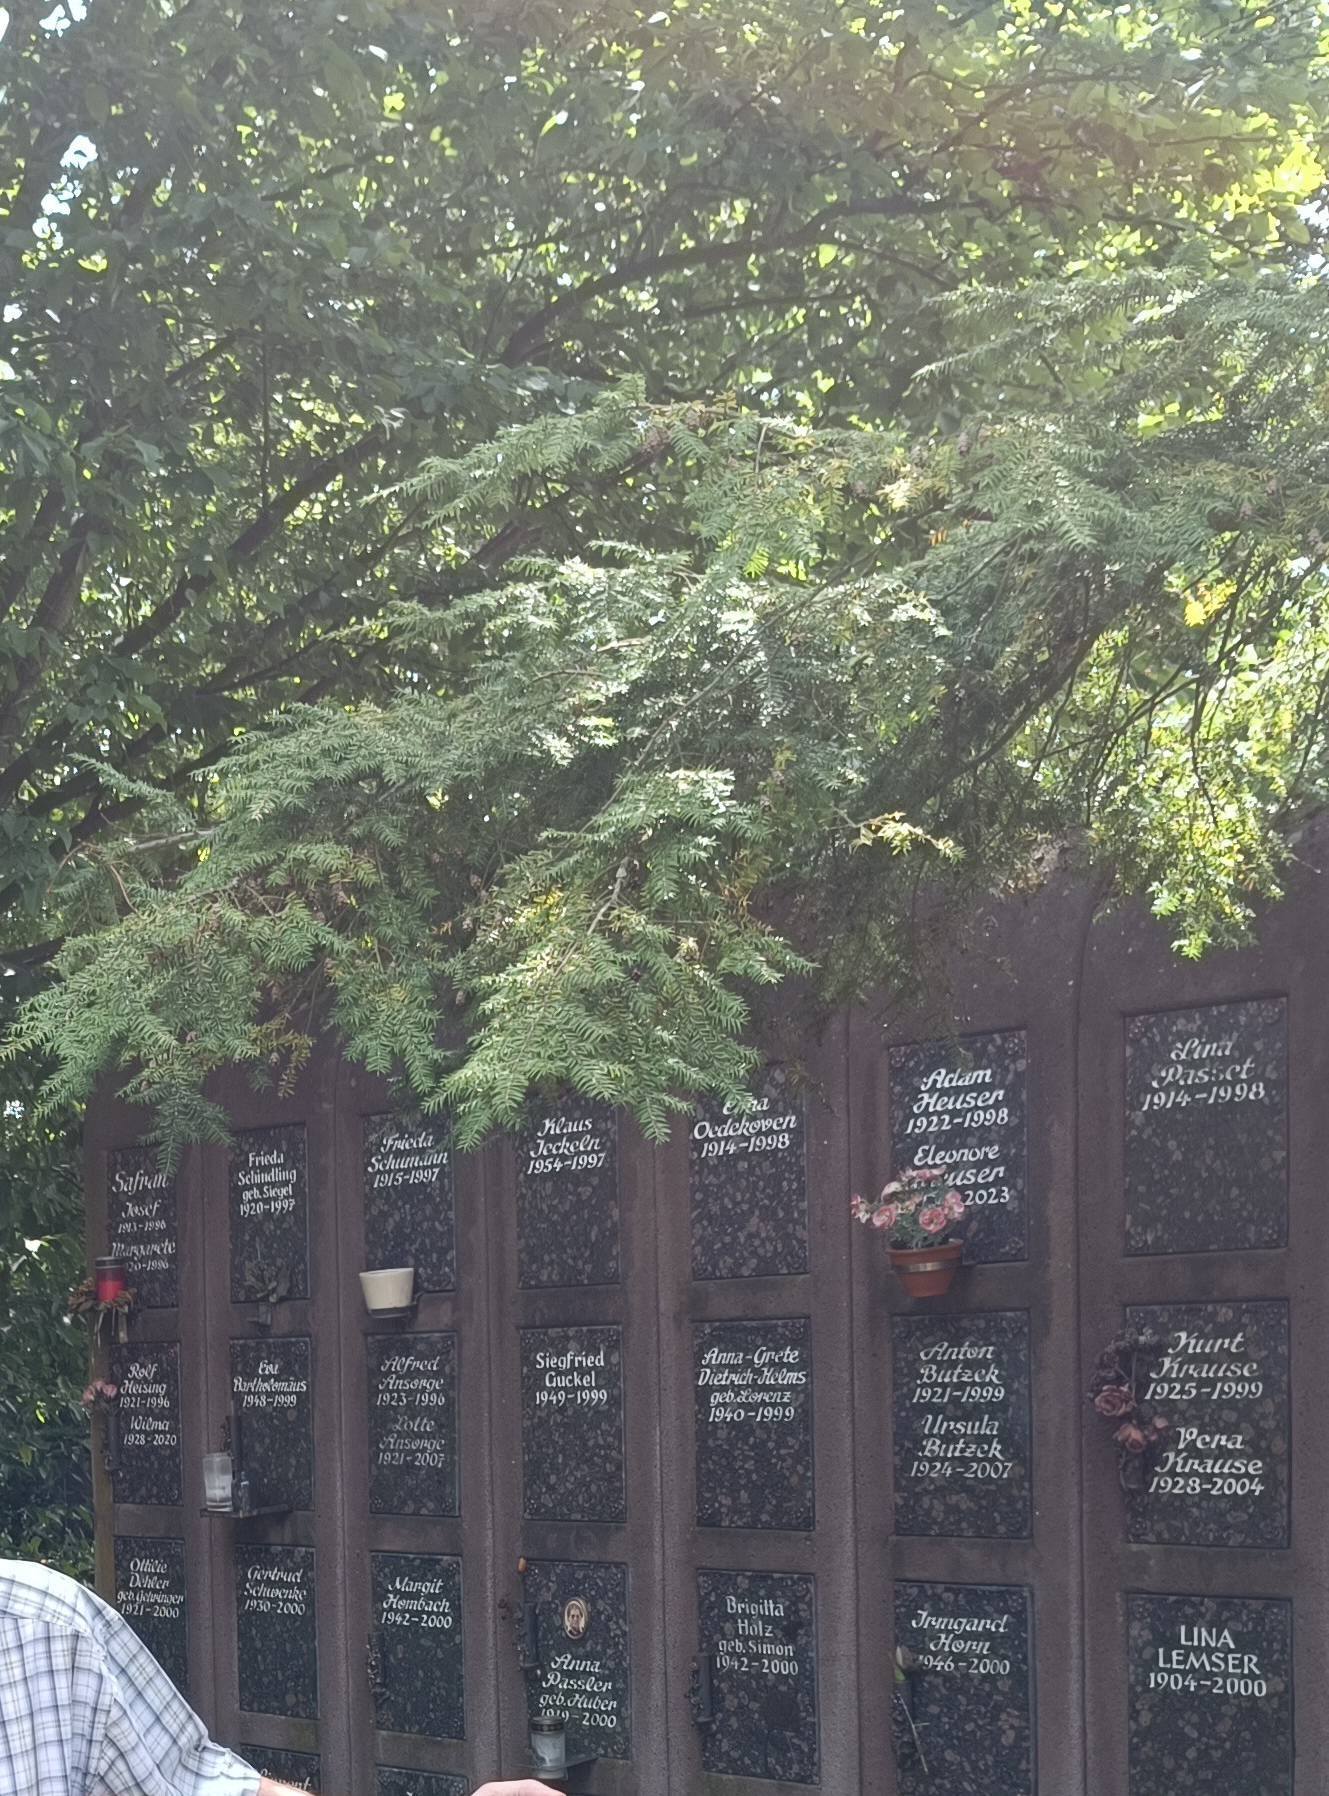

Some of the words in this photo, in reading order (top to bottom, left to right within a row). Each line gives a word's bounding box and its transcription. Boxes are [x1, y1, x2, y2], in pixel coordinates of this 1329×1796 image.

[1171, 1038, 1233, 1060] Lina
[921, 1068, 992, 1091] Adam
[913, 1090, 1005, 1114] Heuser
[1141, 1082, 1266, 1111] 1914-1998
[537, 1117, 592, 1137] Klaus
[904, 1108, 1008, 1134] 1922-1998
[381, 1132, 434, 1153] Frieda
[701, 1133, 790, 1158] 1914-1998
[248, 1150, 284, 1167] Frieda
[367, 1152, 448, 1173] Schumann
[527, 1153, 606, 1174] 1954-1997
[914, 1145, 1000, 1166] Eleonore
[373, 1168, 440, 1188] 1915-1997
[263, 1184, 293, 1200] Siegel
[122, 1200, 161, 1218] Josef
[240, 1199, 295, 1217] 1920-1997
[920, 1341, 995, 1361] Anton
[1168, 1331, 1244, 1354] Kurt
[381, 1356, 440, 1374] Alfred
[535, 1349, 605, 1370] Siegfried
[1150, 1356, 1260, 1379] Krause
[128, 1363, 158, 1380] Rolf
[545, 1371, 596, 1387] Guckel
[120, 1380, 167, 1396] Heising
[379, 1374, 444, 1392] Ansorge
[1144, 1381, 1263, 1400] 1925-1999
[120, 1397, 170, 1408] 1921-1996
[536, 1389, 608, 1407] 1949-1999
[912, 1386, 1005, 1403] 1921-1999
[130, 1416, 169, 1431] Wilma
[921, 1414, 999, 1435] Ursula
[379, 1433, 445, 1453] Ansorge
[1176, 1427, 1245, 1450] Vera
[918, 1438, 1005, 1460] Butzek
[911, 1461, 1013, 1478] 1924-2007
[1155, 1451, 1263, 1474] Krause
[247, 1565, 303, 1582] Gertrud
[388, 1577, 444, 1596] Margit
[382, 1593, 451, 1612] Hombach
[381, 1612, 452, 1628] 1942-2000
[737, 1619, 773, 1636] Holz
[911, 1610, 1008, 1634] Irmgard
[929, 1633, 991, 1654] Horn
[1180, 1625, 1235, 1649] LINA
[748, 1640, 793, 1657] Simon
[551, 1654, 600, 1672] Anna
[1158, 1647, 1261, 1675] LEMSER
[542, 1671, 612, 1692] Passler
[1149, 1672, 1267, 1697] 1904-2000
[567, 1694, 617, 1711] Huber
